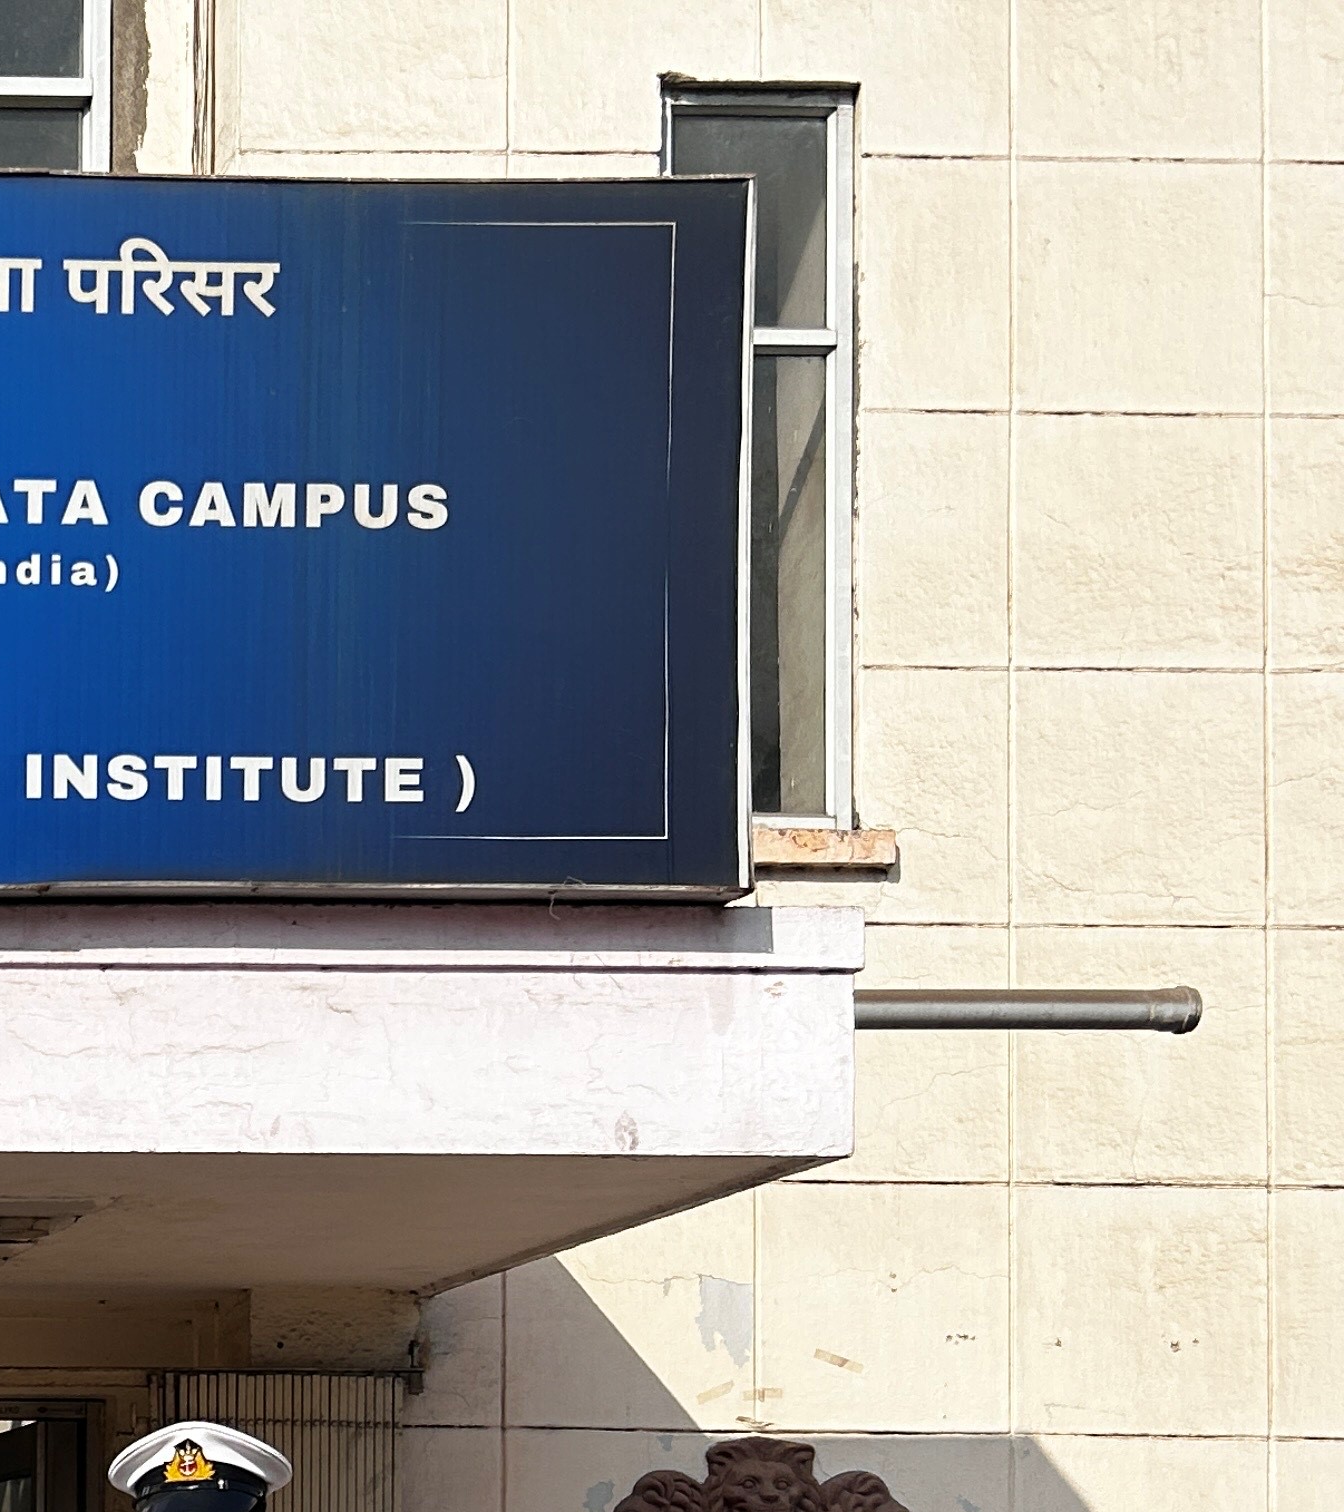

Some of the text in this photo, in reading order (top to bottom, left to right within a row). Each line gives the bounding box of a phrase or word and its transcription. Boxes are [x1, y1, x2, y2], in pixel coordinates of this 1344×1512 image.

[62, 237, 281, 318] परिसर
[138, 480, 449, 530] CAMPUS
[26, 753, 424, 803] INSTITUTE
